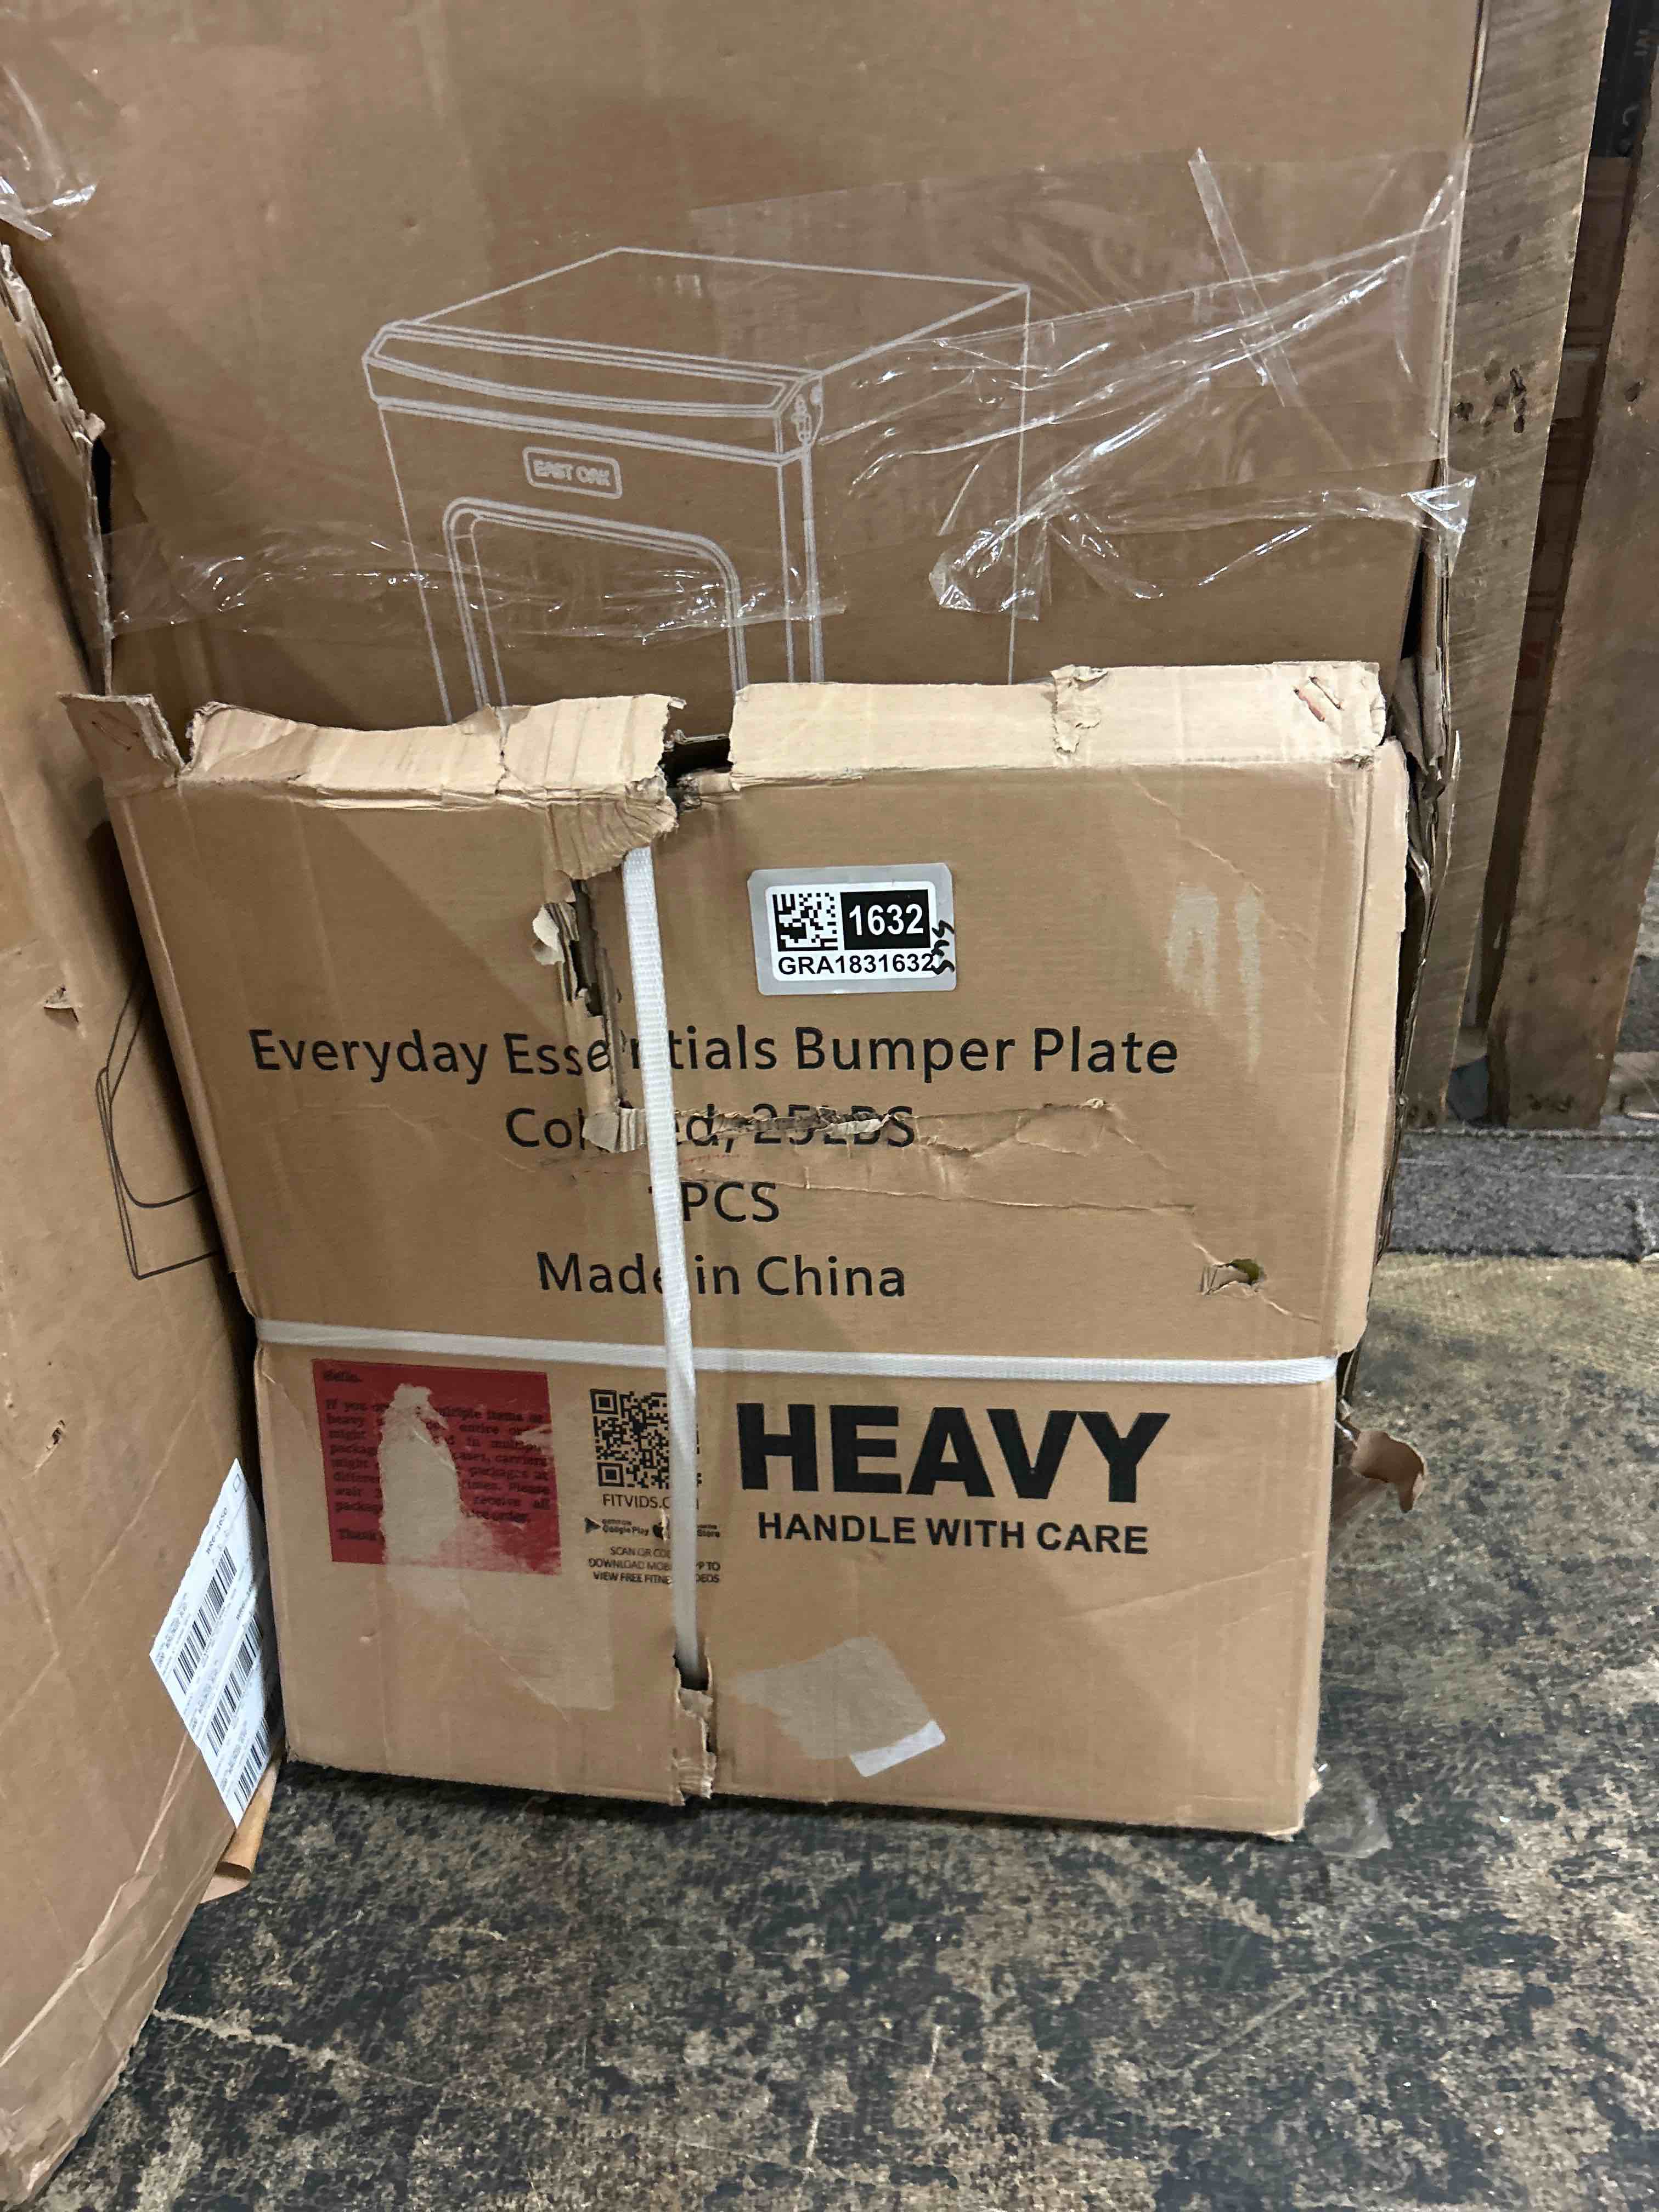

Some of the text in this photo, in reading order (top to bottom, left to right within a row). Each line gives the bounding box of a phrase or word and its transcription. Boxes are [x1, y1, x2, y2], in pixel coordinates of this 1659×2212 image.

[849, 904, 924, 935] 1632
[778, 953, 934, 975] GRA1831632
[249, 1029, 488, 1084] Everyday
[795, 1026, 1015, 1083] Bumper
[1034, 1026, 1178, 1074] Plate
[505, 1103, 733, 1153] Cold,
[695, 1255, 740, 1295] in
[757, 1255, 905, 1297] China
[736, 1403, 1171, 1503] HEAVY
[602, 1493, 699, 1510] FITVIDS.C
[758, 1512, 1148, 1555] HANDLE WITH CARE
[645, 1575, 672, 1585] FITNE
